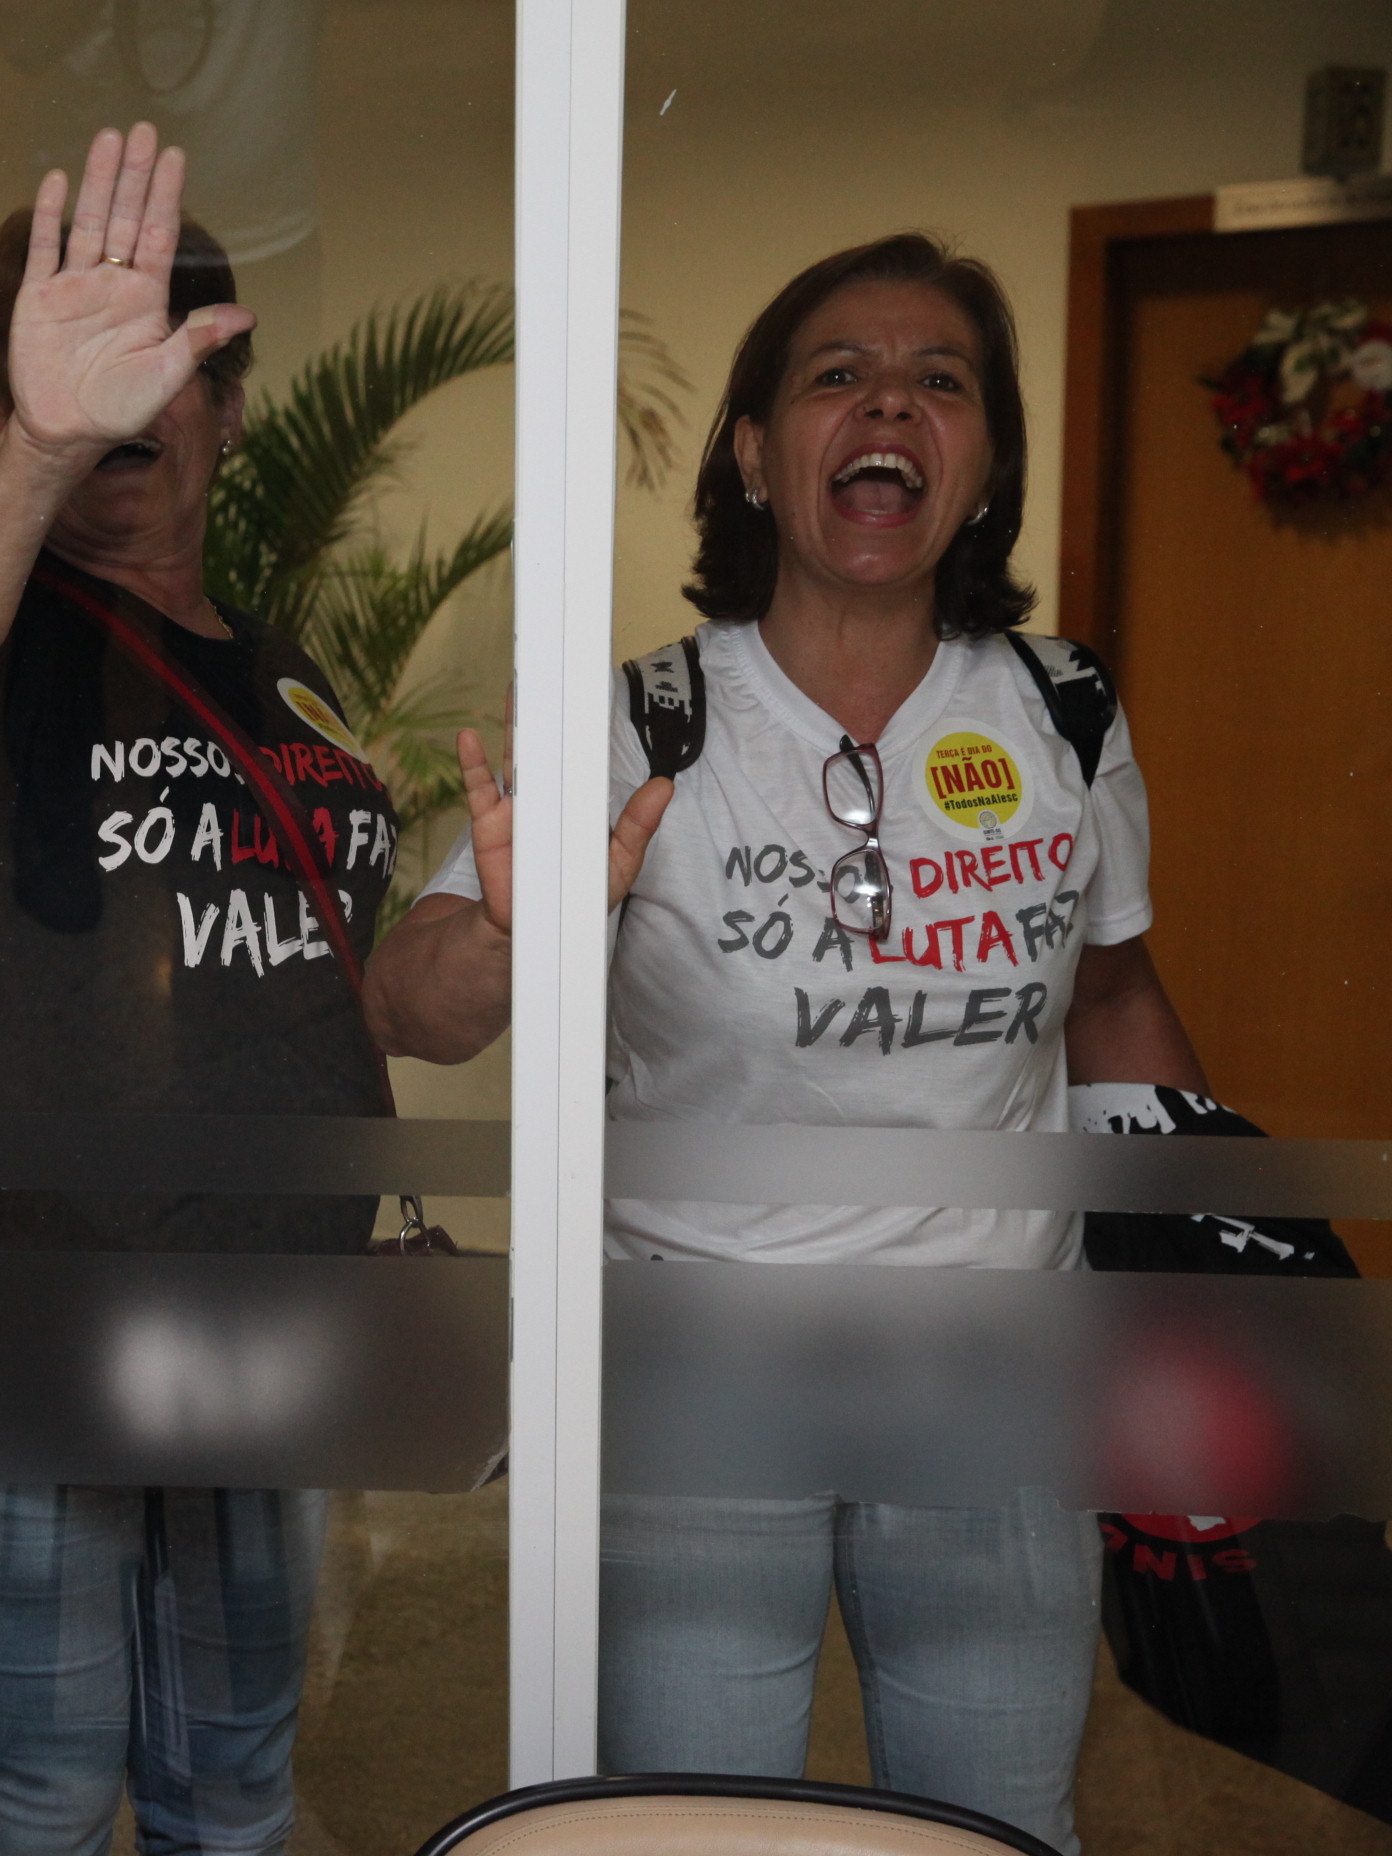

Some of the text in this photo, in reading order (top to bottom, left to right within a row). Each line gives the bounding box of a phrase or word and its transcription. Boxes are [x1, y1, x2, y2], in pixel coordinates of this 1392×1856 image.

[90, 735, 246, 784] NOSSO
[936, 748, 959, 759] TERÇA
[967, 746, 980, 756] DIA
[981, 744, 992, 754] DO
[930, 756, 1015, 799] [NÃO]
[944, 793, 1018, 811] #TodosNaAlesc
[97, 785, 176, 872] SÓ
[190, 802, 224, 872] A
[231, 806, 340, 871] LUA
[717, 893, 793, 960] SÓ
[812, 916, 855, 972] A
[868, 910, 1019, 973] LUTA
[793, 981, 1048, 1056] VALER
